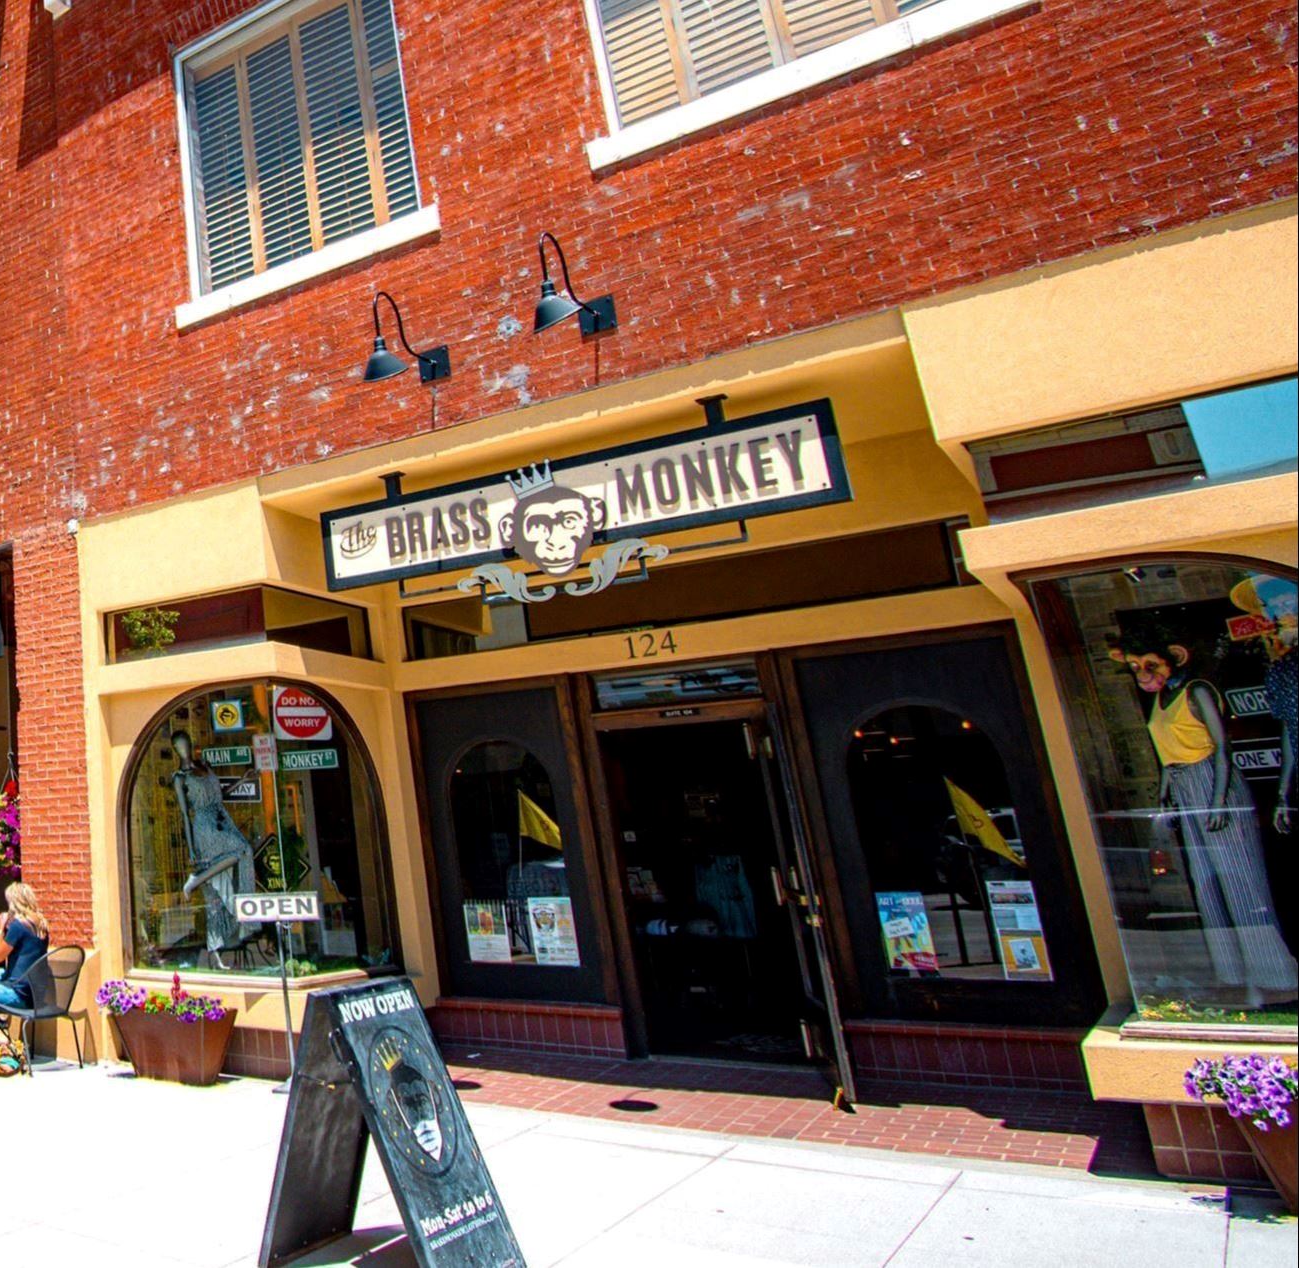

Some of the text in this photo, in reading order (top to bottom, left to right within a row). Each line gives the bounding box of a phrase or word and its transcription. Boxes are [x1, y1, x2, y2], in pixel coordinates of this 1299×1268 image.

[340, 430, 805, 560] The BRASS MONKEY
[623, 630, 678, 660] 124
[281, 696, 297, 706] DO
[1232, 689, 1270, 713] NOR
[284, 718, 320, 728] WORRY
[205, 748, 248, 763] MAIN AVE
[282, 753, 324, 769] MONKEY
[325, 751, 333, 760] ST
[1235, 751, 1269, 768] ONE
[240, 898, 314, 916] OPEN
[338, 989, 415, 1024] NOW OPEN
[484, 1189, 494, 1206] 6
